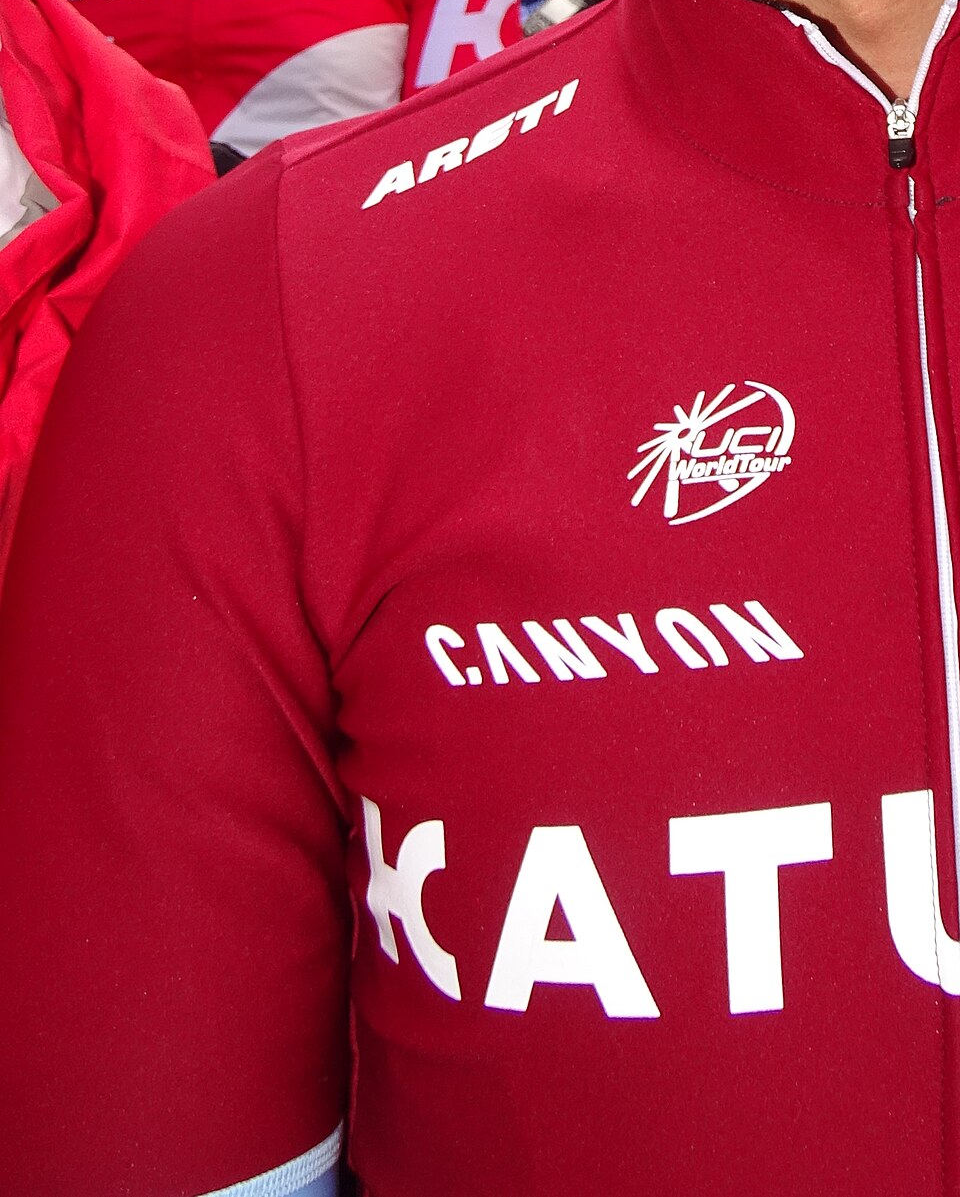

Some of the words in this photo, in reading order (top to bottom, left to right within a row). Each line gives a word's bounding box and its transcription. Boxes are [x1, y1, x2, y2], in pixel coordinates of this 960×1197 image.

[361, 78, 579, 210] ARETI
[669, 453, 792, 482] WorldTour
[692, 425, 783, 458] UCI
[425, 600, 804, 687] CANYON
